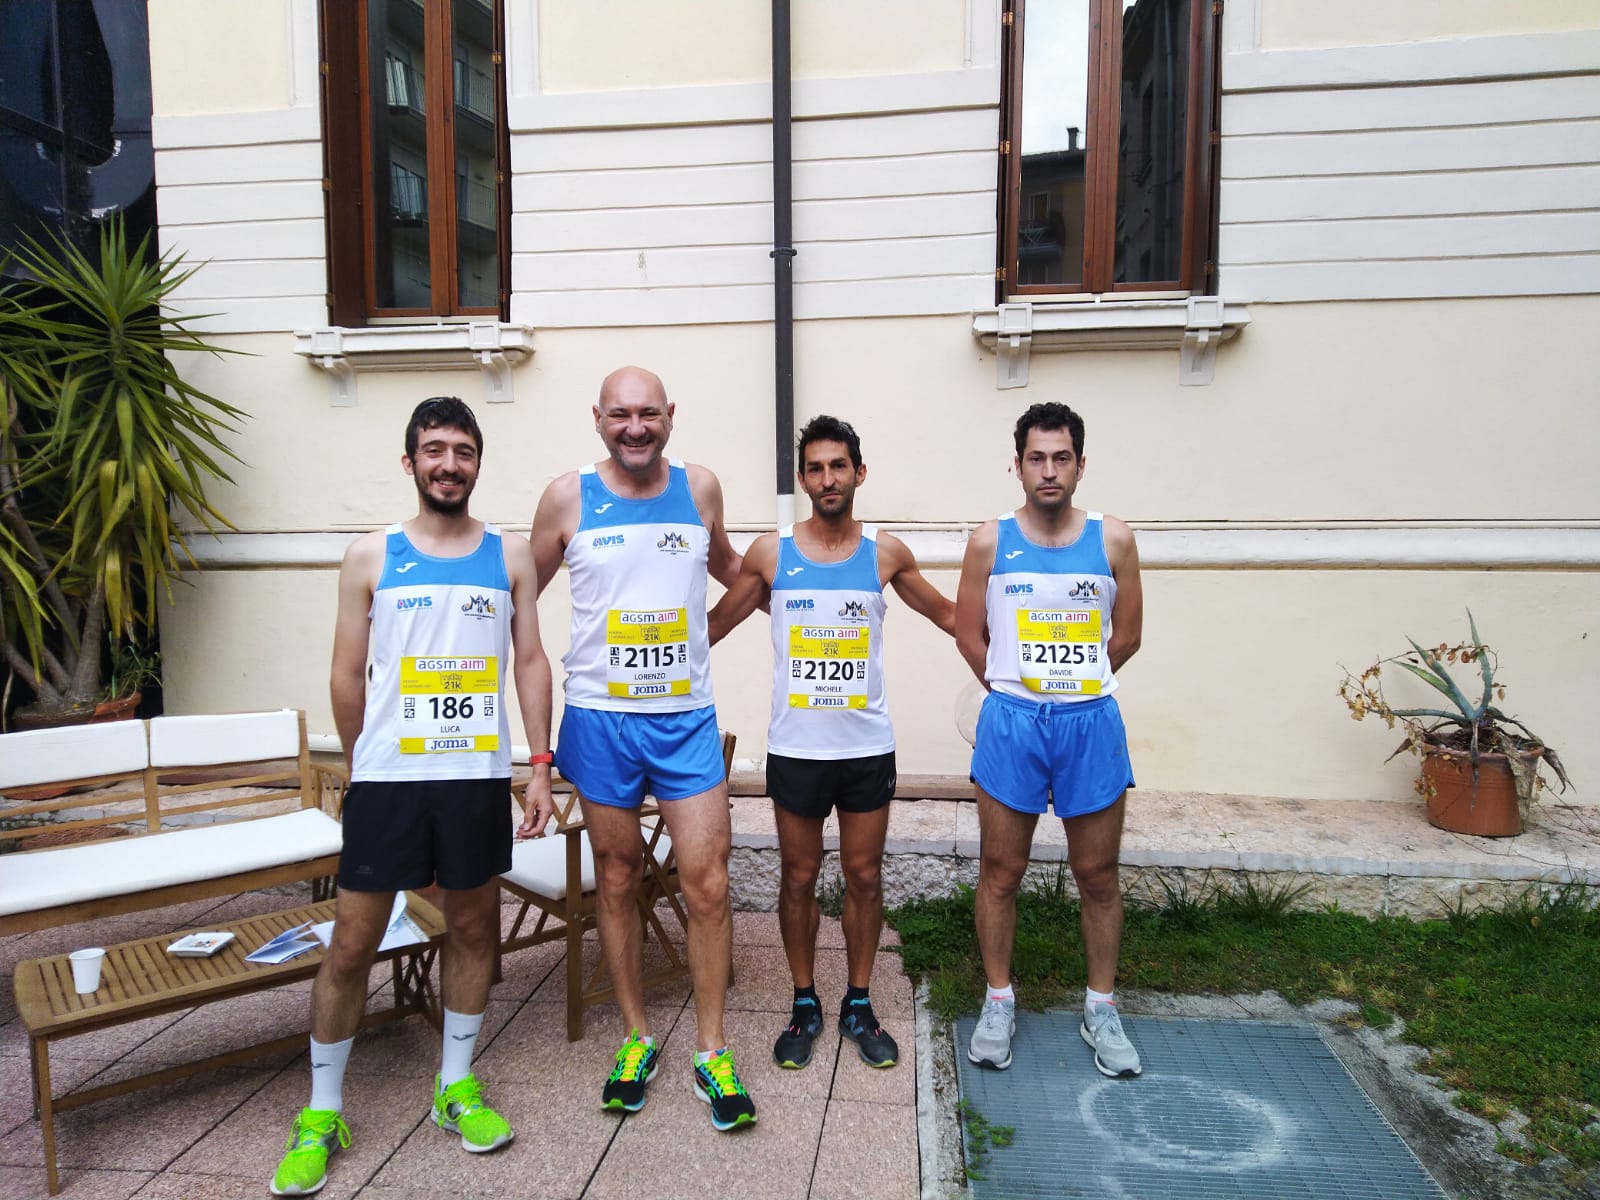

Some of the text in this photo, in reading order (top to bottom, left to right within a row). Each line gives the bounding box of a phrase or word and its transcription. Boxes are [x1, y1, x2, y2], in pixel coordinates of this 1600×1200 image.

[592, 534, 624, 548] AVIS
[1005, 584, 1033, 594] AVIS
[397, 596, 432, 608] AVIS
[786, 599, 814, 608] AVIS
[625, 646, 674, 668] 2115
[1035, 644, 1085, 664] 2125
[634, 672, 666, 680] LORENZO
[804, 660, 854, 680] 2120
[429, 696, 474, 719] 186
